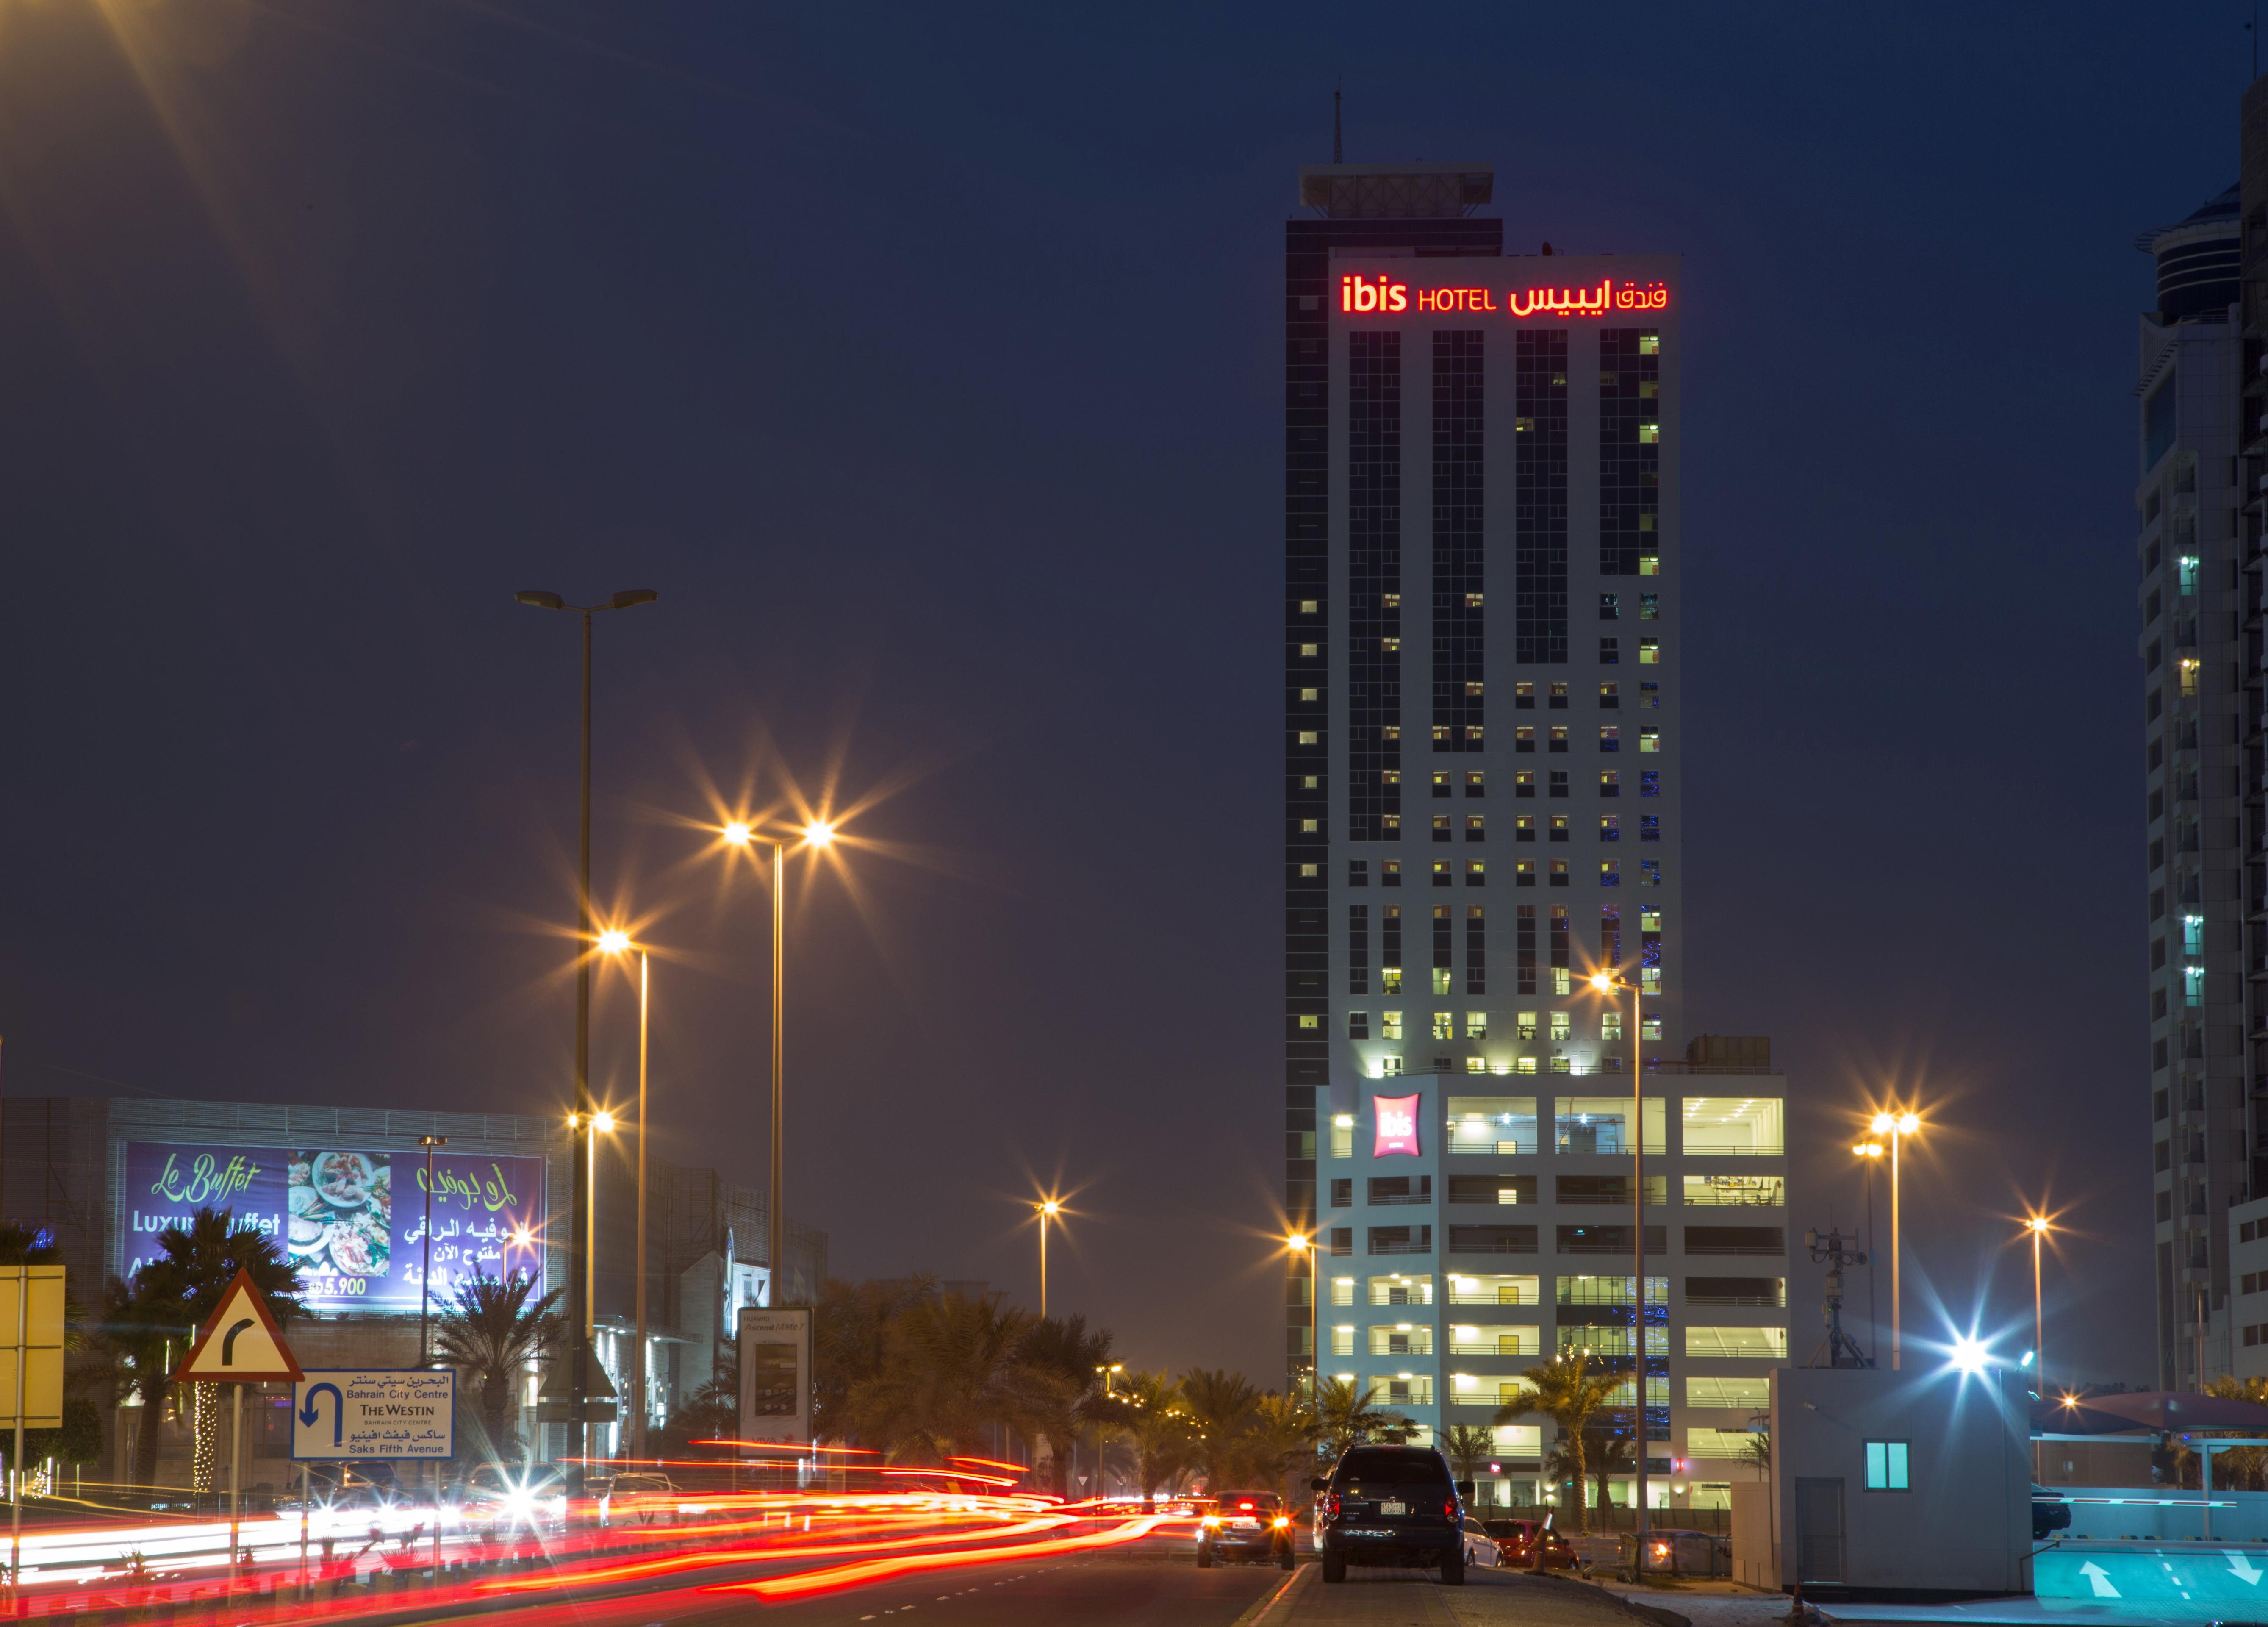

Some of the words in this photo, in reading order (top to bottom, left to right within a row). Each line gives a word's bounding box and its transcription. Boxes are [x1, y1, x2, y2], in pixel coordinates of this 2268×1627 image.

[1343, 275, 1407, 312] ibis
[1419, 289, 1496, 311] HOTEL
[1510, 280, 1610, 316] ايبيس
[1616, 282, 1666, 309] فندق
[1380, 1111, 1413, 1137] ibis
[151, 1153, 185, 1202] Le
[186, 1153, 261, 1203] Buffet
[324, 1277, 366, 1295] 5.900
[348, 1375, 376, 1387] سنتر
[377, 1376, 405, 1388] سيتي
[406, 1375, 449, 1389] البحرين
[347, 1390, 385, 1399] Bahrain
[389, 1390, 409, 1400] City
[414, 1390, 448, 1399] Centre
[385, 1405, 434, 1416] WESTIN
[382, 1430, 410, 1441] فيفث
[412, 1430, 445, 1441] ساكس
[349, 1445, 375, 1453] Saks
[380, 1445, 402, 1453] Fifth
[407, 1445, 444, 1453] Avenue
